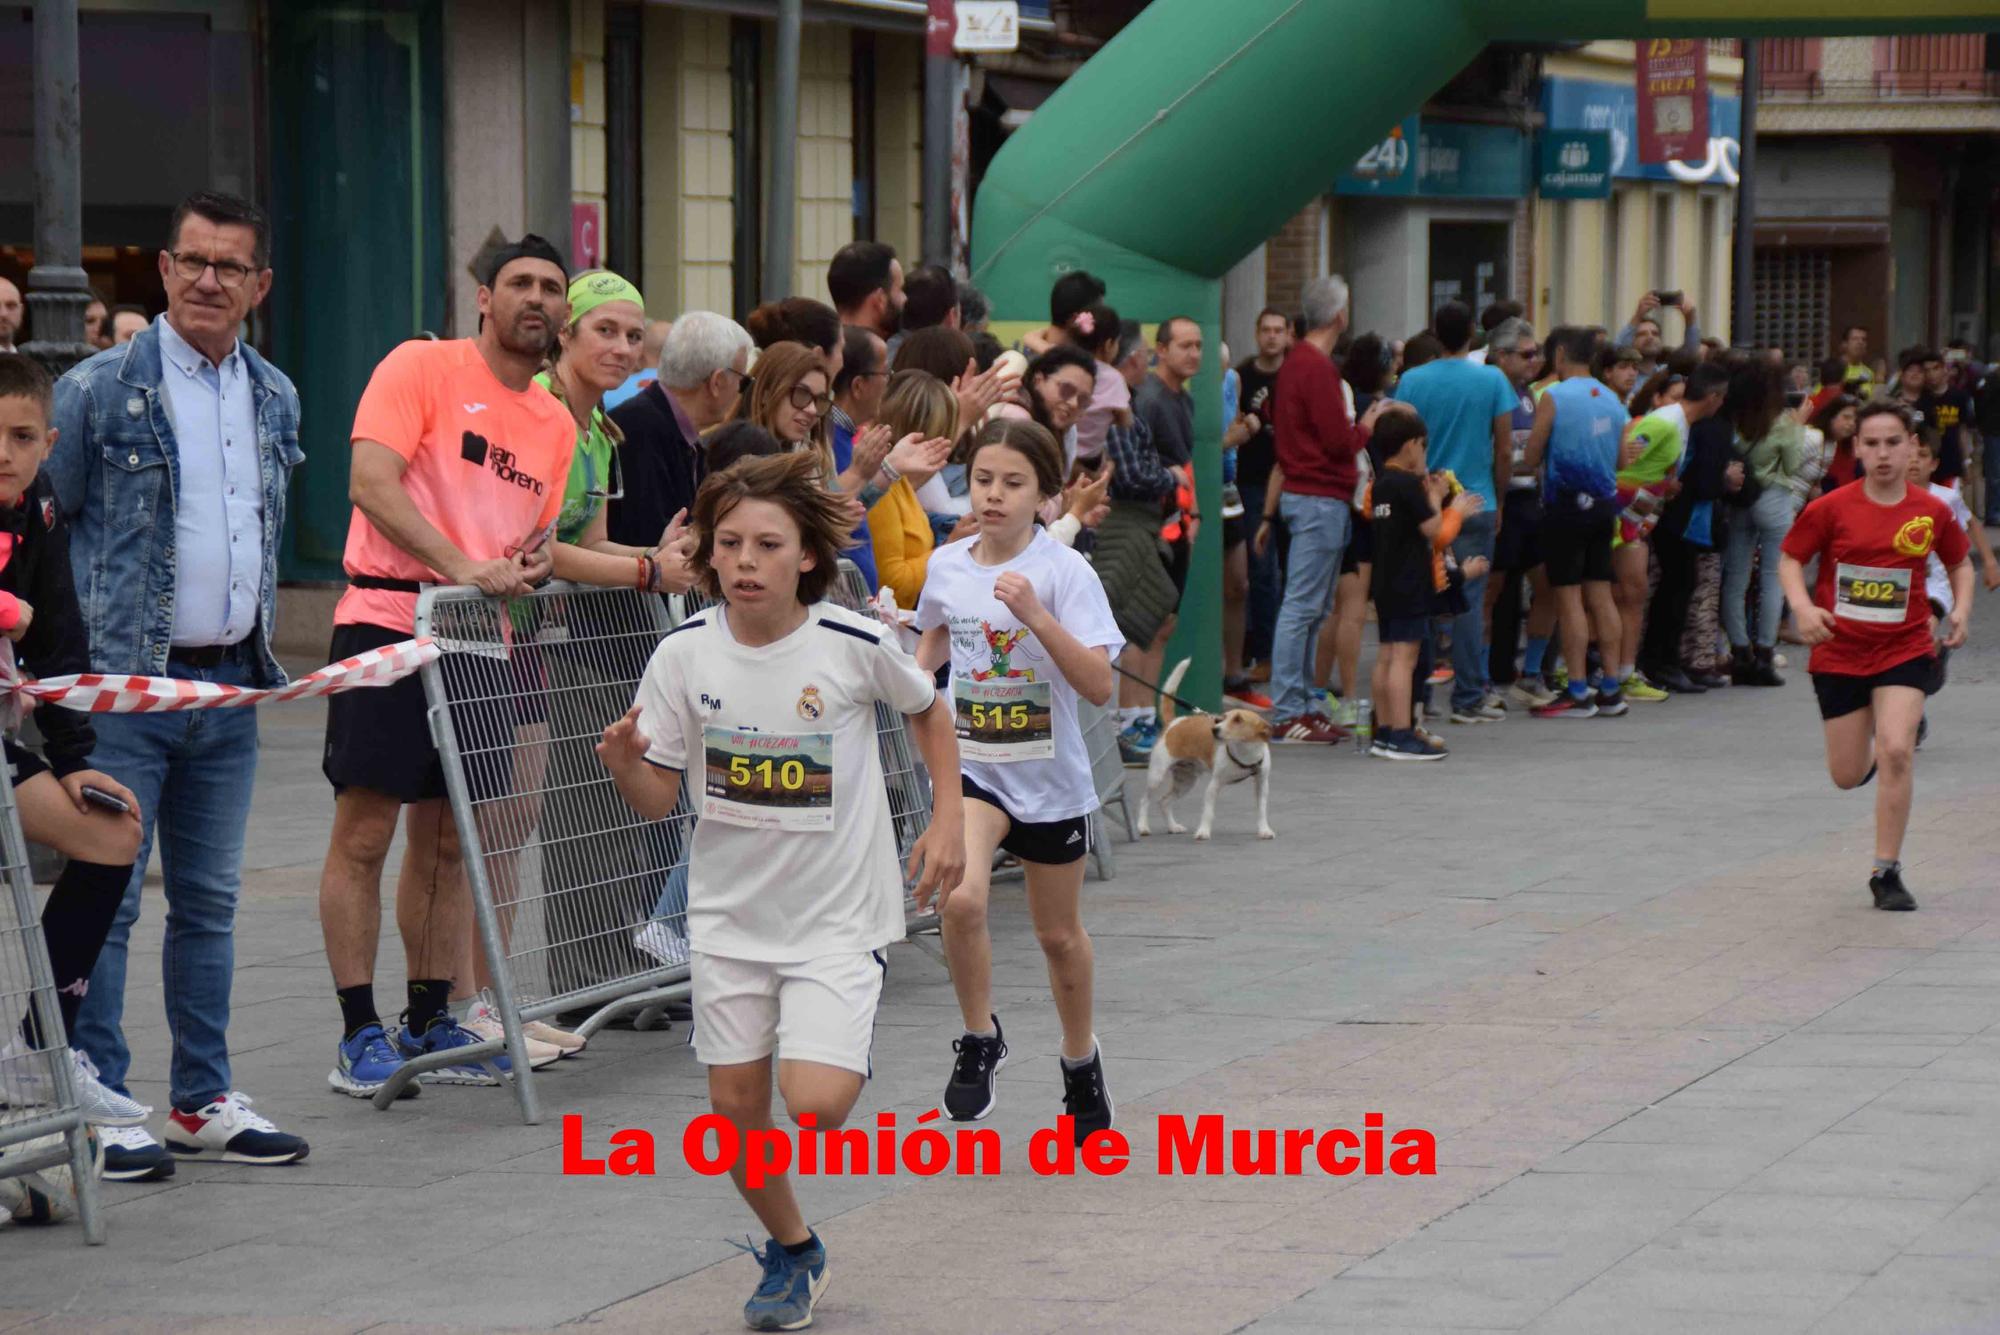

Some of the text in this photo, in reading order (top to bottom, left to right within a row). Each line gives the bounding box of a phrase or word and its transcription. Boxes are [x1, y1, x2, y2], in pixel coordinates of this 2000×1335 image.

[1545, 172, 1604, 186] cajamar
[1852, 580, 1894, 600] 502
[972, 704, 1029, 729] 515
[730, 756, 805, 790] 510
